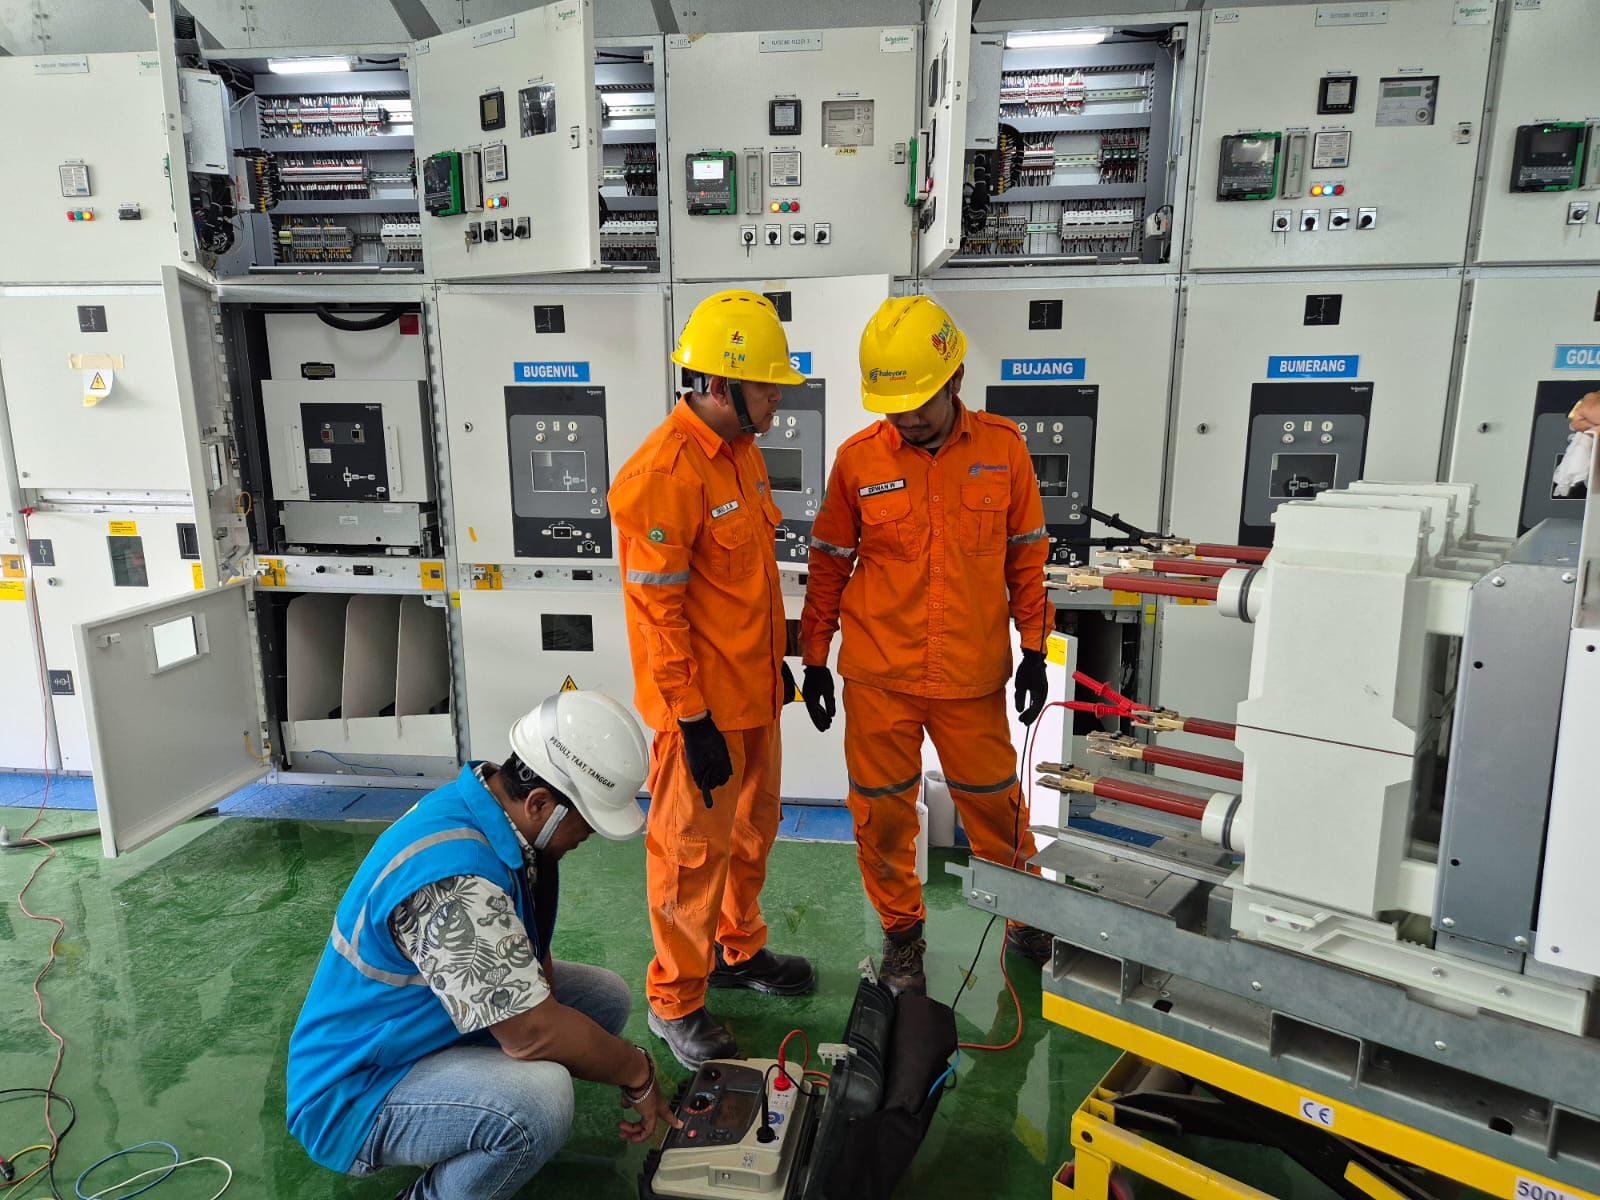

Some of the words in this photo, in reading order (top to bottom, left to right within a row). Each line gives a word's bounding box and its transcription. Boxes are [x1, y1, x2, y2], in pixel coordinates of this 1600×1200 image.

[723, 351, 746, 362] PLN
[523, 365, 579, 378] BUGENVIL
[1012, 362, 1073, 375] BUJANG
[1280, 360, 1346, 373] BUMERANG
[571, 755, 587, 772] TAAT,
[588, 768, 616, 788] TANGGAP
[1303, 1102, 1330, 1124] CE
